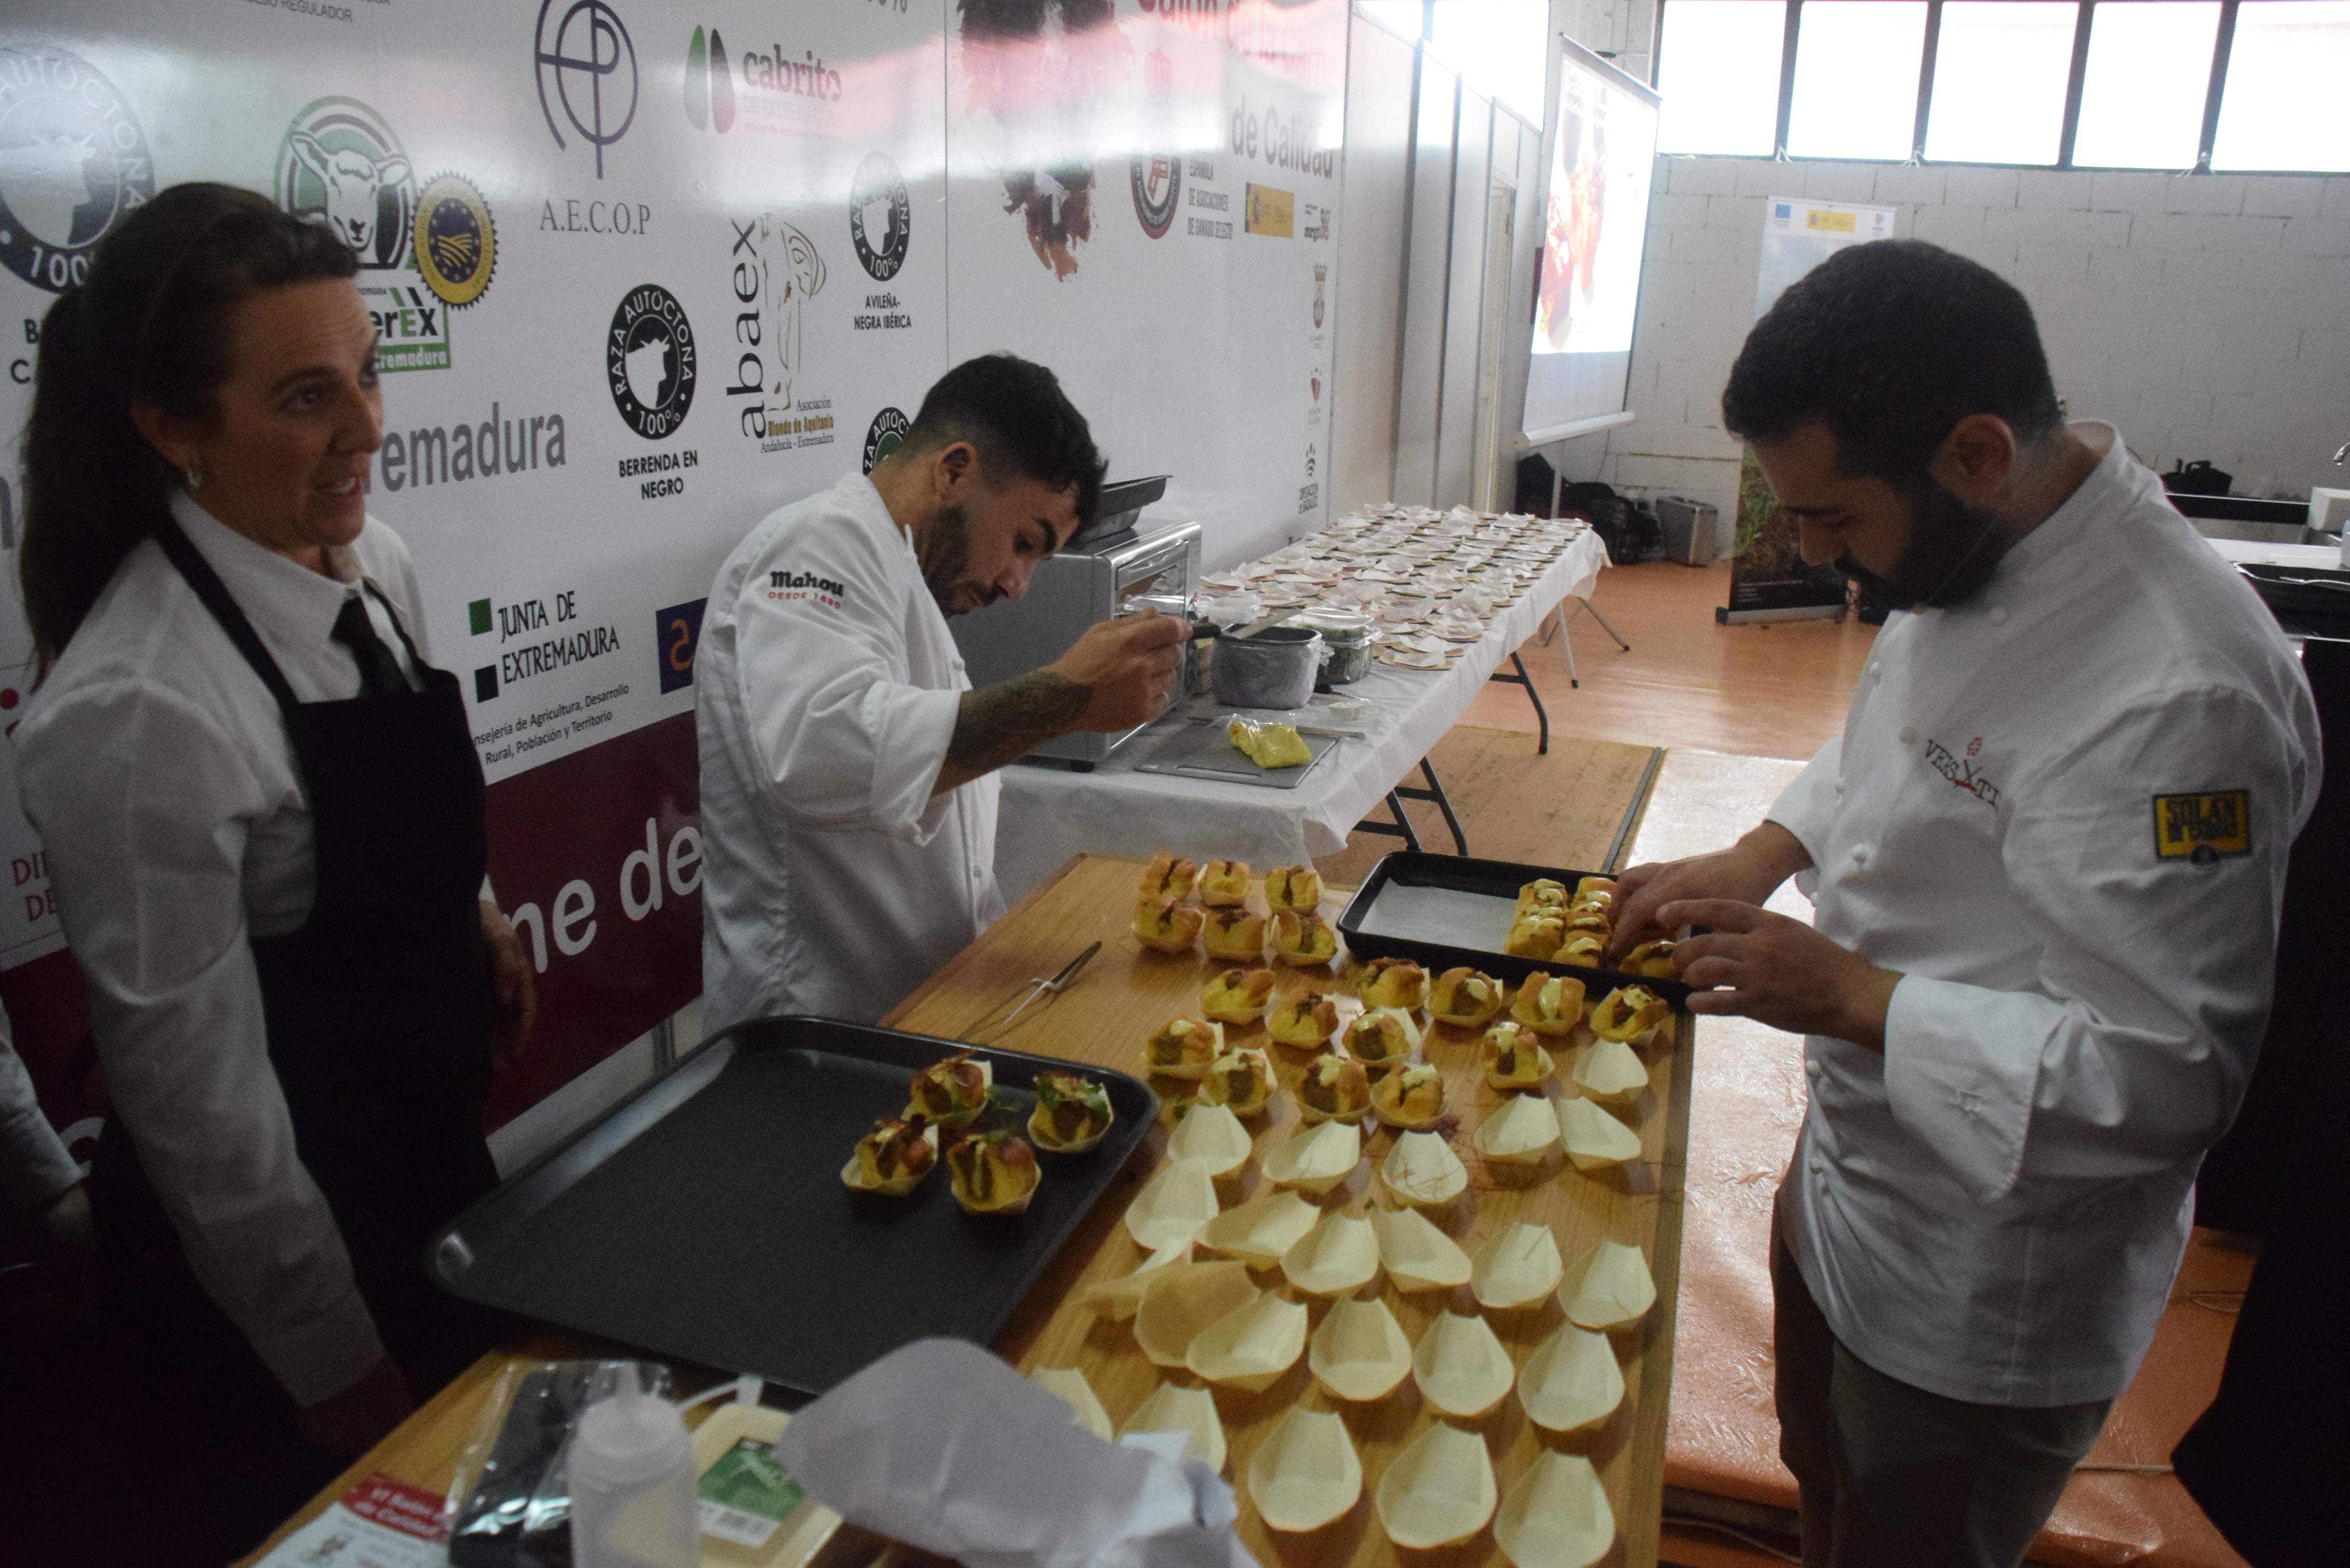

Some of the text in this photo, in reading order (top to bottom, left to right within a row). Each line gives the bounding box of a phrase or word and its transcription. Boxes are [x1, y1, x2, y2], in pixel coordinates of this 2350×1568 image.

[743, 43, 842, 103] cabrito
[1232, 94, 1258, 159] de
[1189, 188, 1195, 205] DE
[1188, 217, 1194, 235] DE
[30, 247, 95, 286] 100
[870, 255, 898, 278] 100%
[727, 218, 766, 439] abaex
[854, 311, 912, 330] NEGRA IBÉRICA
[612, 329, 627, 395] RAZA
[639, 403, 680, 435] 100%
[794, 418, 801, 433] de
[873, 411, 909, 441] AUTÓC
[618, 450, 698, 478] BERRENDA EN
[641, 478, 684, 500] NEGRO
[768, 591, 807, 600] DESDE
[770, 571, 844, 597] Mahou
[498, 591, 577, 643] JUNTA DE
[502, 626, 620, 684] EXTREMADURA
[516, 718, 527, 732] de
[530, 701, 583, 728] Agricultura,
[585, 684, 629, 707] Desarrollo
[486, 710, 613, 765] Rural, Población y Territorio
[619, 817, 703, 921] de
